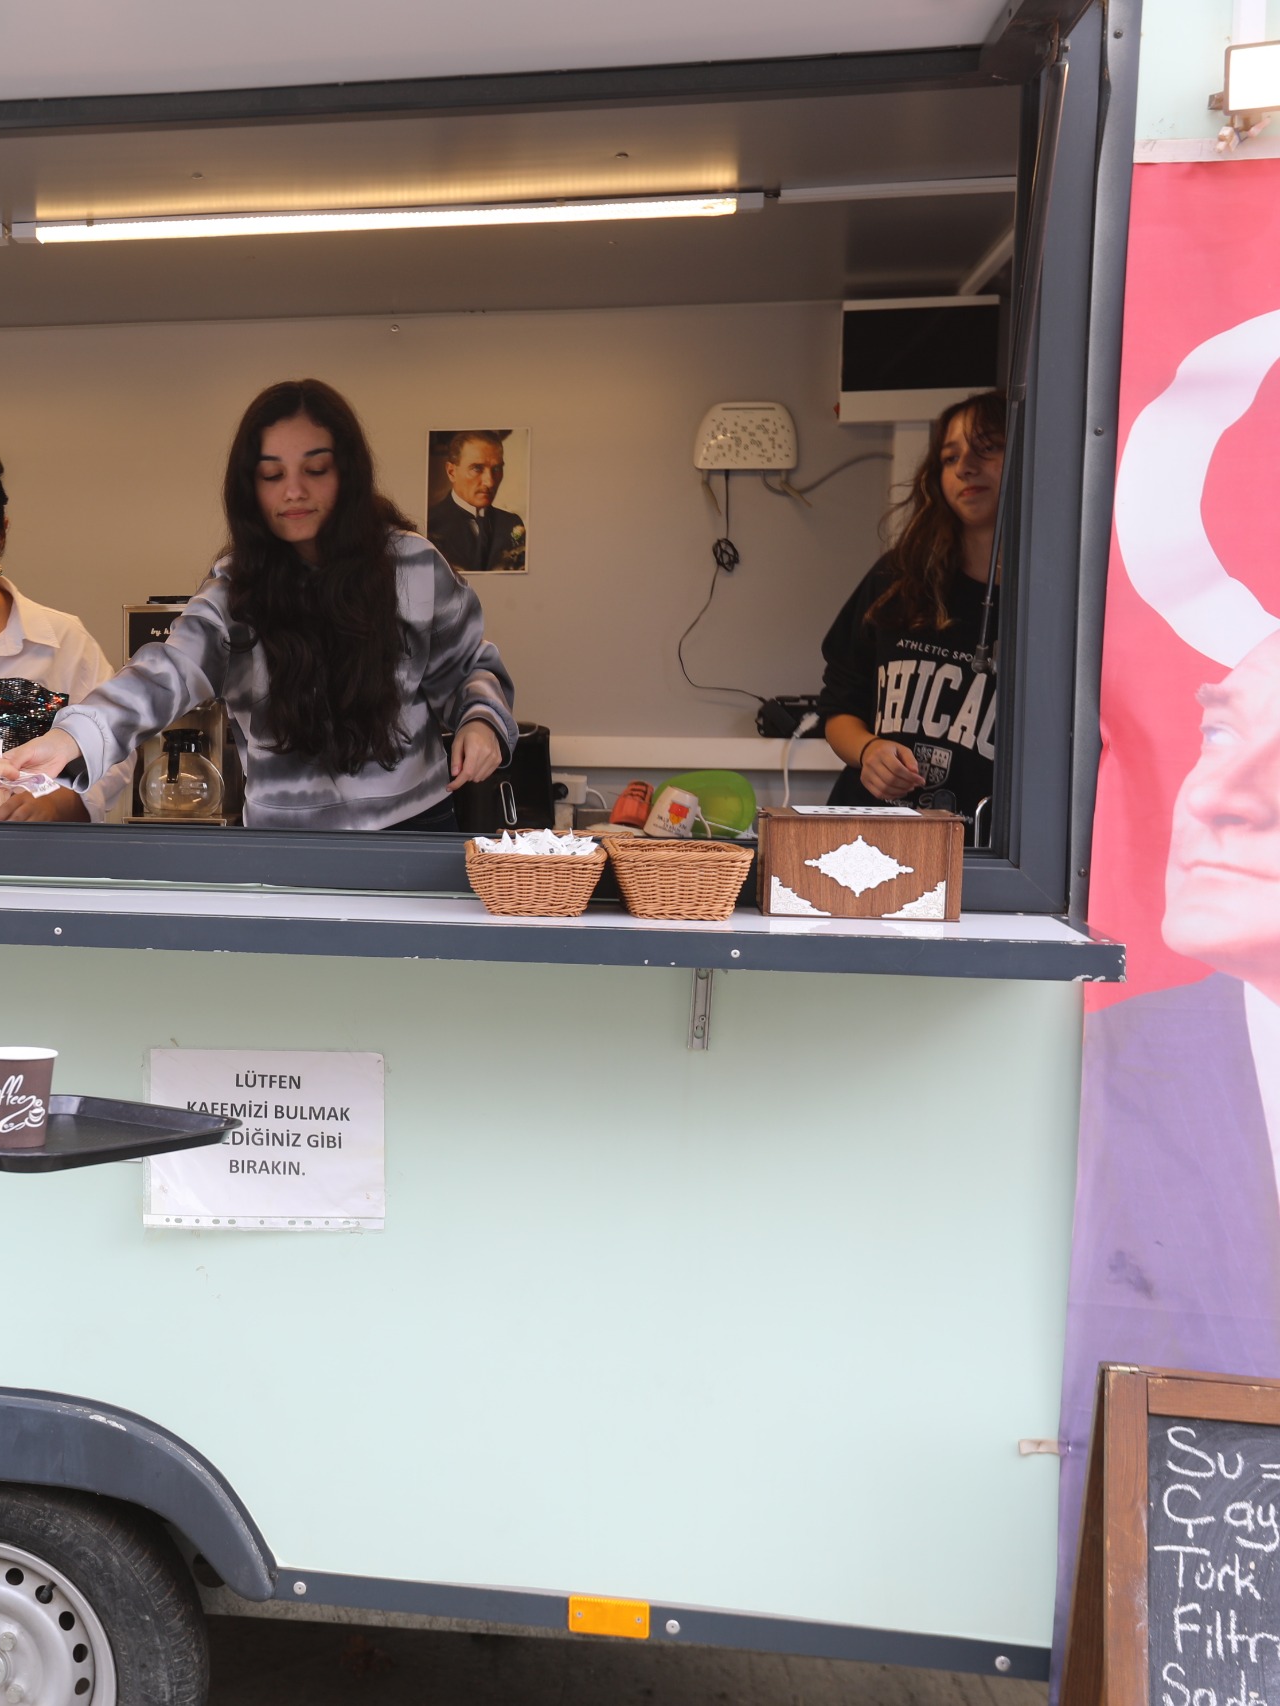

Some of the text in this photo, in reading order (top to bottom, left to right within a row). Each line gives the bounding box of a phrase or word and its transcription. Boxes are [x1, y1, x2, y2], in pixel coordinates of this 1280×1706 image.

[896, 639, 950, 657] ATHLETIC
[235, 1070, 301, 1090] LÜTFEN
[187, 1100, 351, 1122] KAFEMİZİ BULMAK
[306, 1131, 342, 1149] GİBİ
[229, 1159, 306, 1176] BIRAKIN.
[1166, 1425, 1244, 1480] Su
[1163, 1483, 1279, 1552] Çay
[1153, 1545, 1261, 1600] Türk
[1172, 1602, 1280, 1663] Filtr
